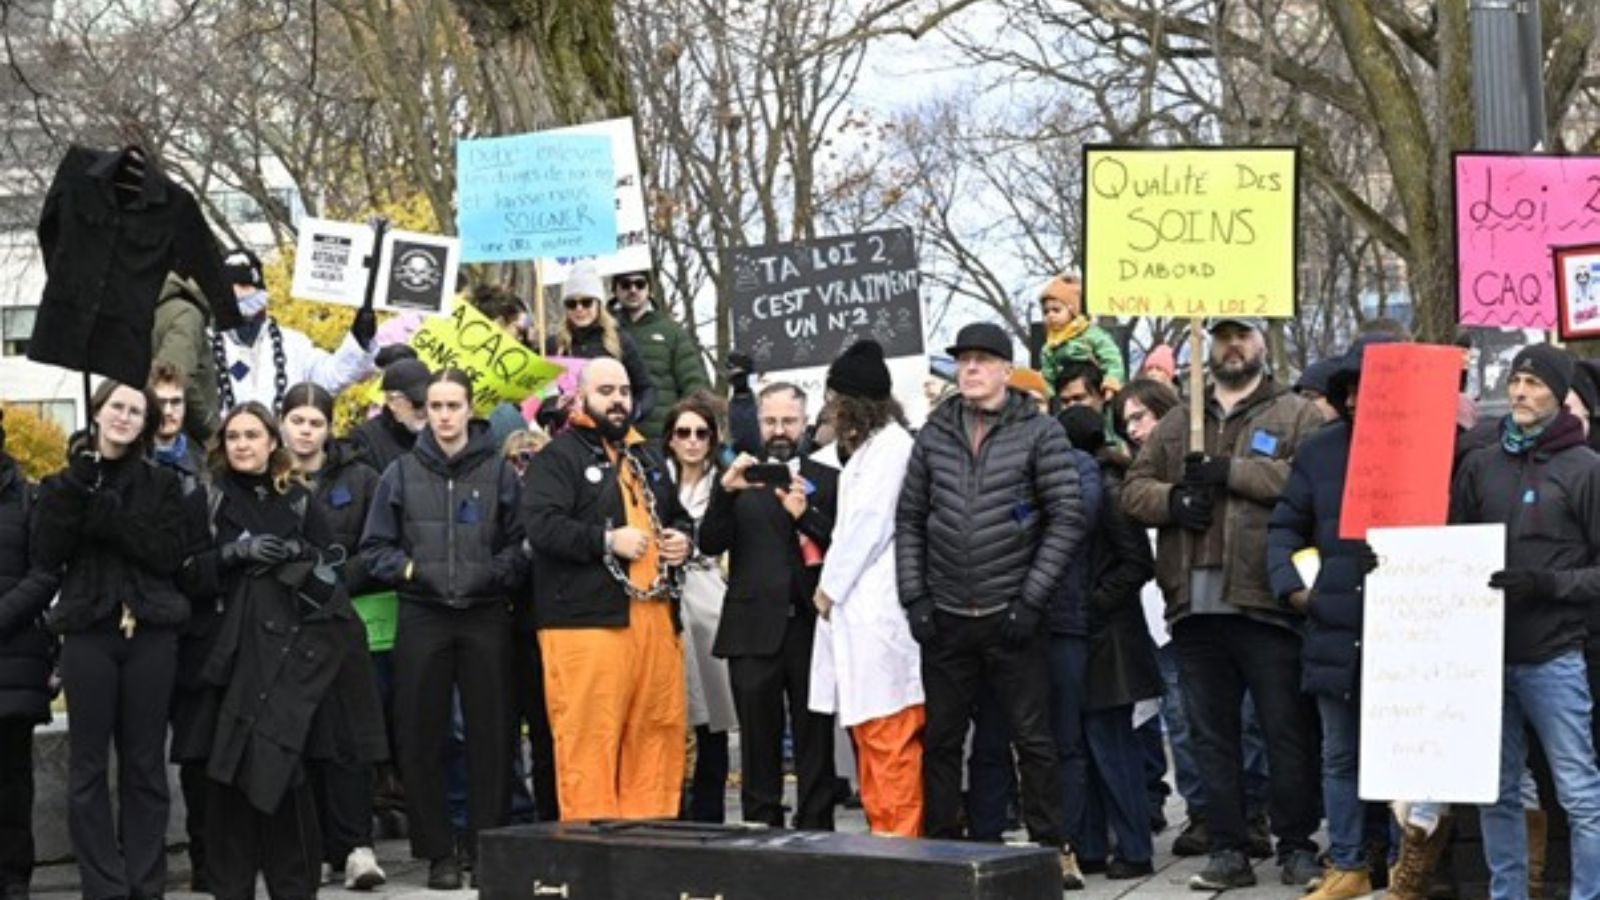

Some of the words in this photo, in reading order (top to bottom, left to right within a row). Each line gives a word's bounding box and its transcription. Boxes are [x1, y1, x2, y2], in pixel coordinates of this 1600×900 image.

[504, 203, 596, 233] SOIGNER
[1127, 206, 1256, 252] SOINS
[758, 256, 800, 283] TA
[812, 241, 858, 270] LOI
[816, 269, 919, 307] VRAIMENT
[1108, 296, 1149, 313] NON
[1187, 299, 1206, 314] LA
[1219, 299, 1246, 314] LOI
[1254, 294, 1268, 314] 2
[1473, 270, 1542, 307] CAQ
[784, 313, 818, 339] UN
